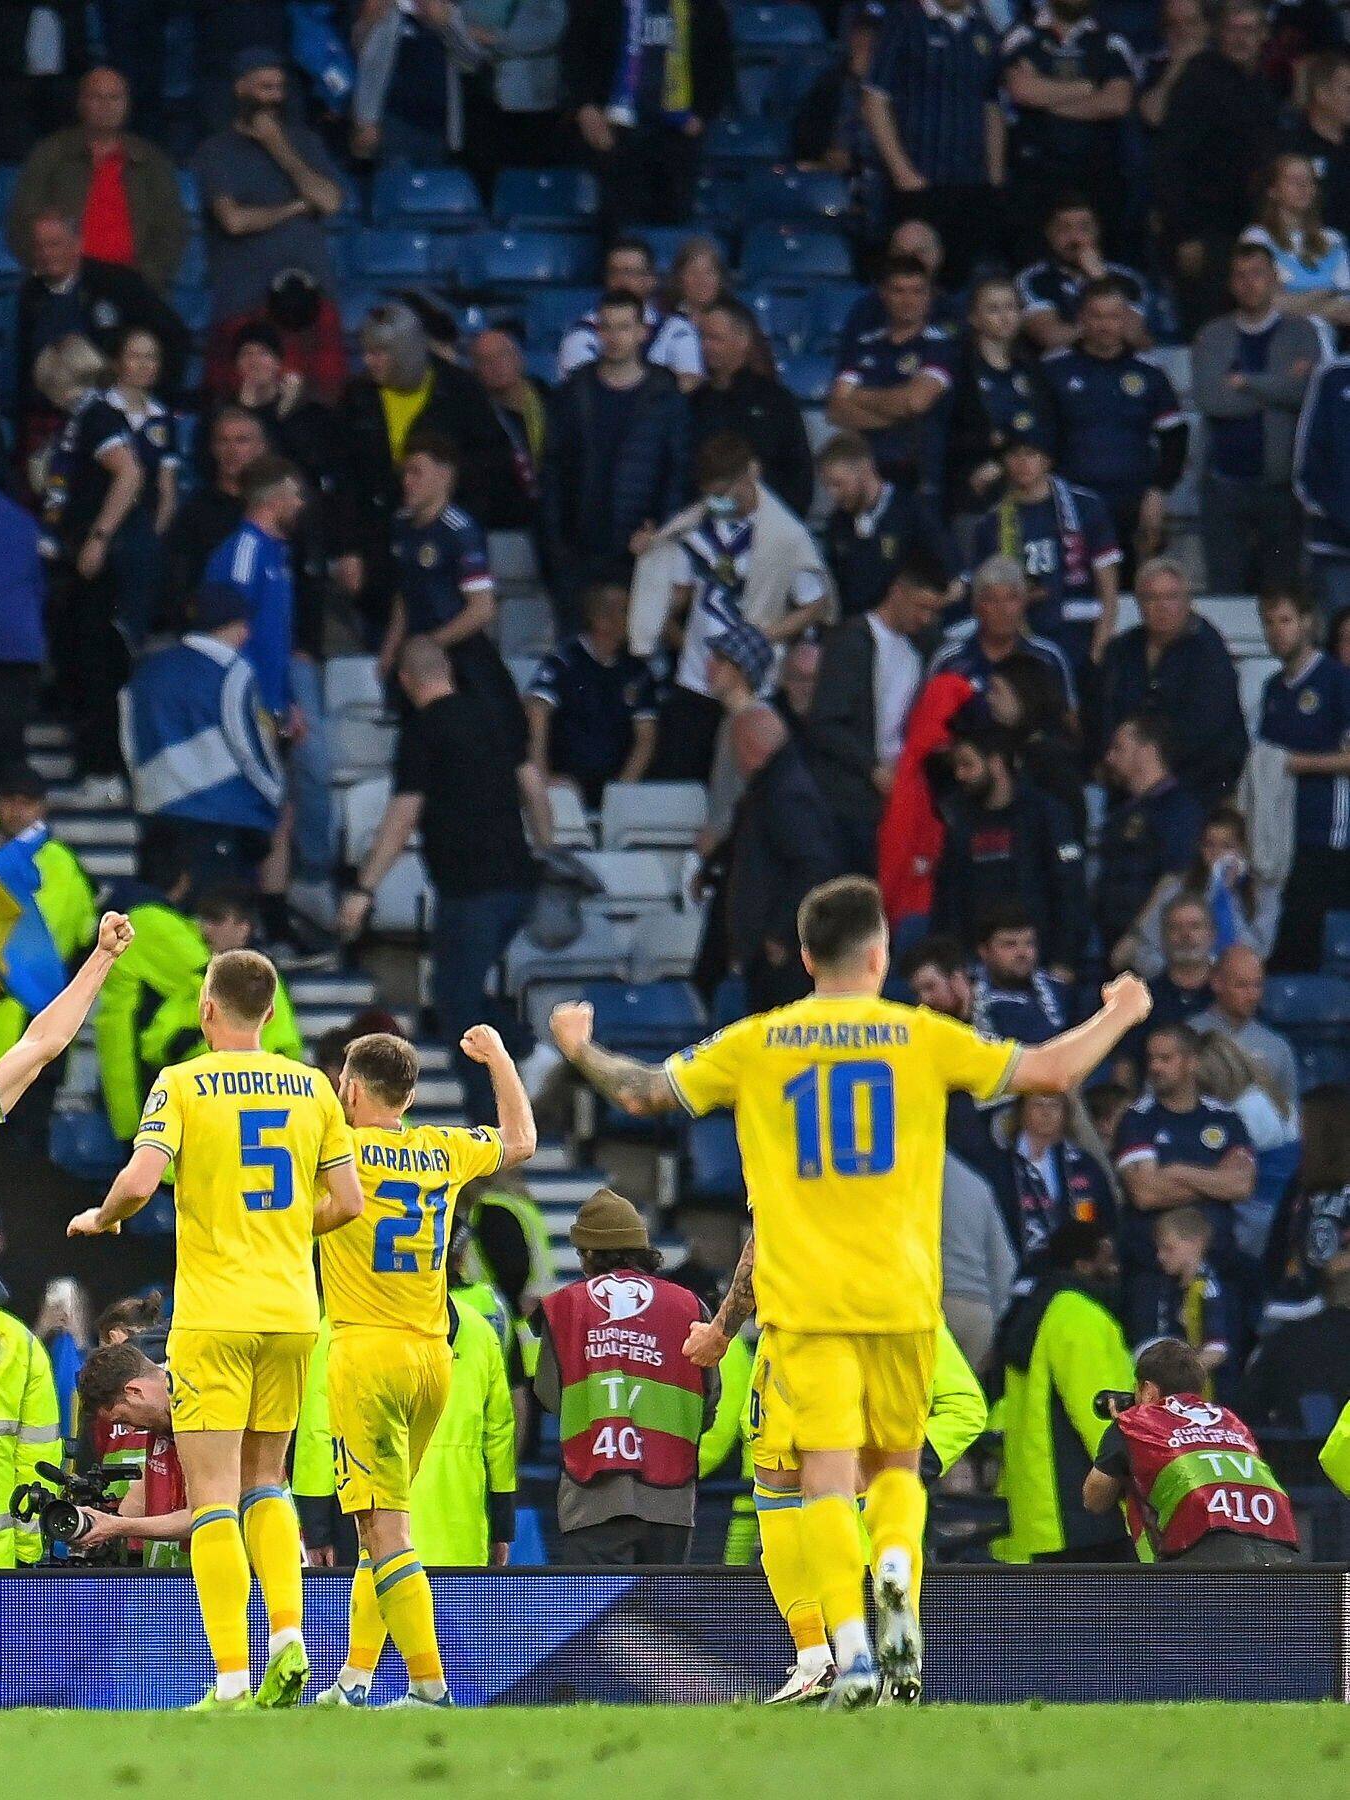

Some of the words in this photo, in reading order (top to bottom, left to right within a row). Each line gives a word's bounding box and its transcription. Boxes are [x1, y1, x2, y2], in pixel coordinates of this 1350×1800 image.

[194, 1071, 315, 1098] SYDORCHUK
[783, 1059, 896, 1179] 10
[238, 1108, 294, 1213] 5
[372, 1179, 450, 1273] 21
[584, 1340, 664, 1367] QUALFIERS
[592, 1425, 644, 1462] 40
[1198, 1453, 1254, 1479] TV
[1207, 1488, 1275, 1526] 410
